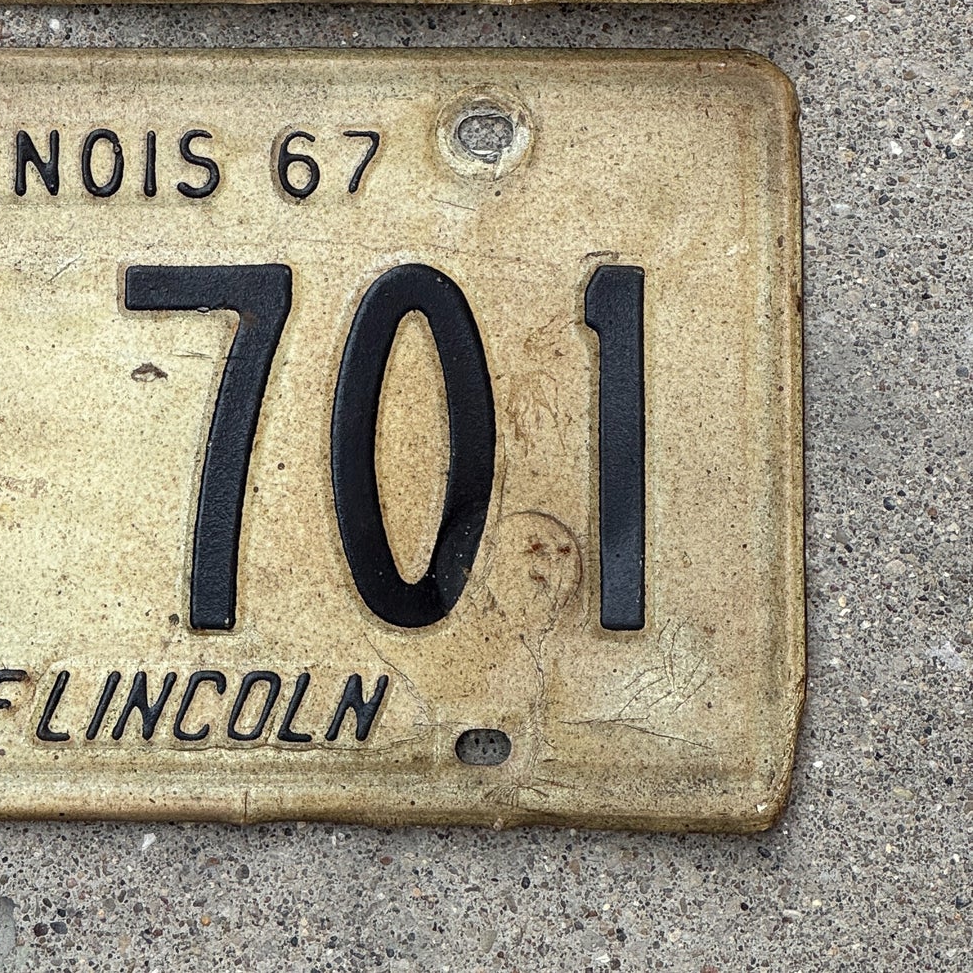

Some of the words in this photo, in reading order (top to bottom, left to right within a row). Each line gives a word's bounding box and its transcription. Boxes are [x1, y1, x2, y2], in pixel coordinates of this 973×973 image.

[277, 130, 380, 200] 67
[124, 263, 647, 632] 701
[35, 670, 389, 743] LINCOLN
